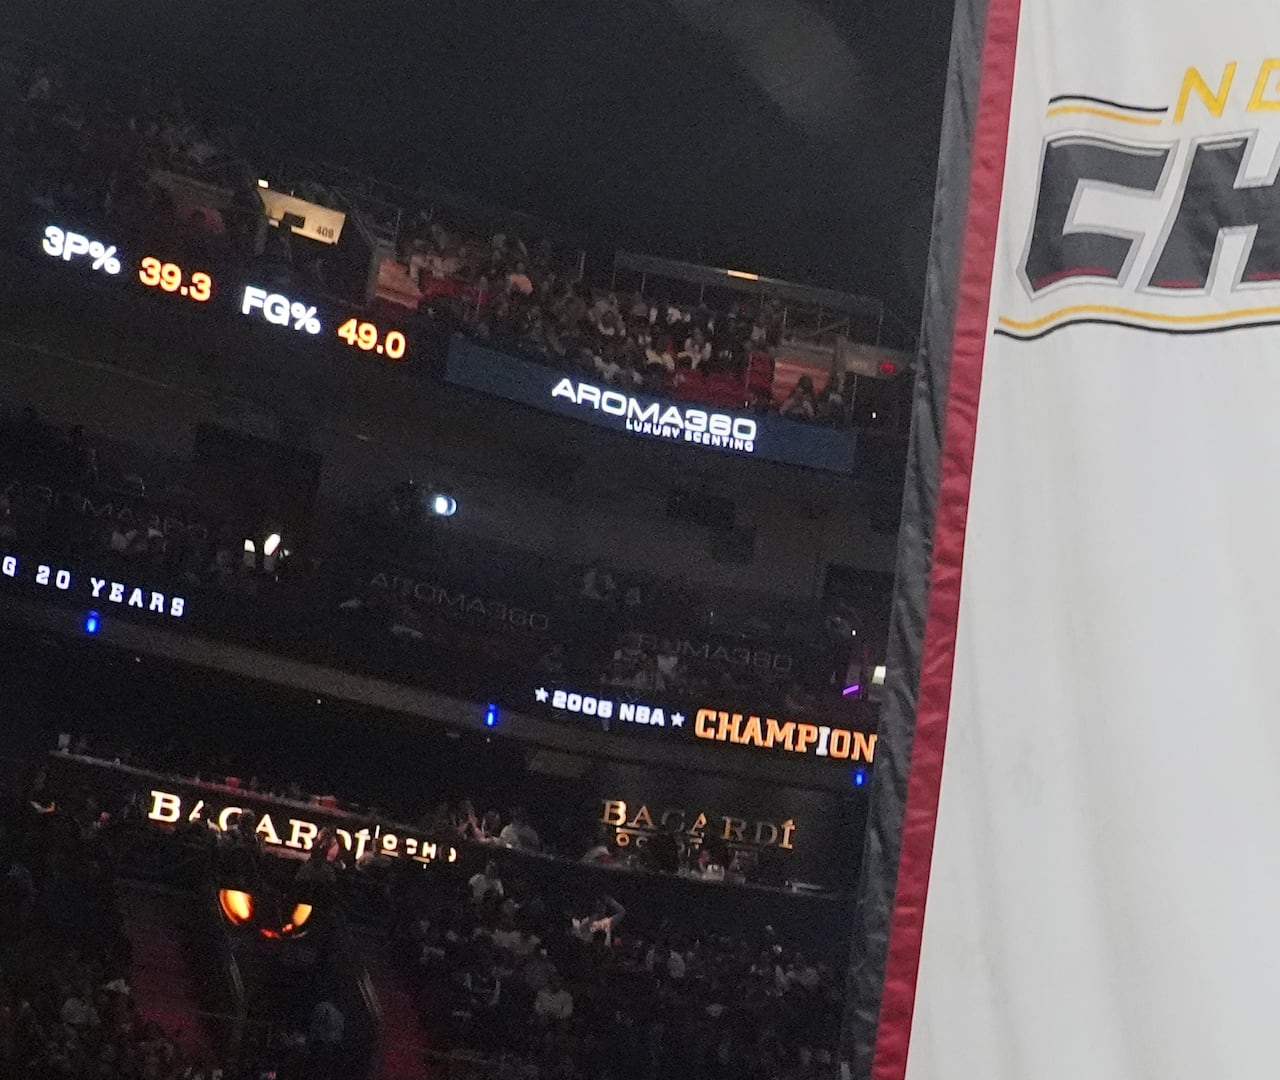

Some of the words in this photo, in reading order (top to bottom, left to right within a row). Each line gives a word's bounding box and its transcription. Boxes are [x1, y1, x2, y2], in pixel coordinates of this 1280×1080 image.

[42, 225, 121, 275] 3P%
[139, 256, 212, 302] 39.3
[242, 286, 321, 335] FG%
[338, 318, 406, 360] 49.0
[551, 378, 757, 441] AROMA360
[35, 563, 72, 591] 20
[90, 576, 186, 618] YEARS
[551, 689, 613, 720] 2006
[618, 701, 666, 727] NBA
